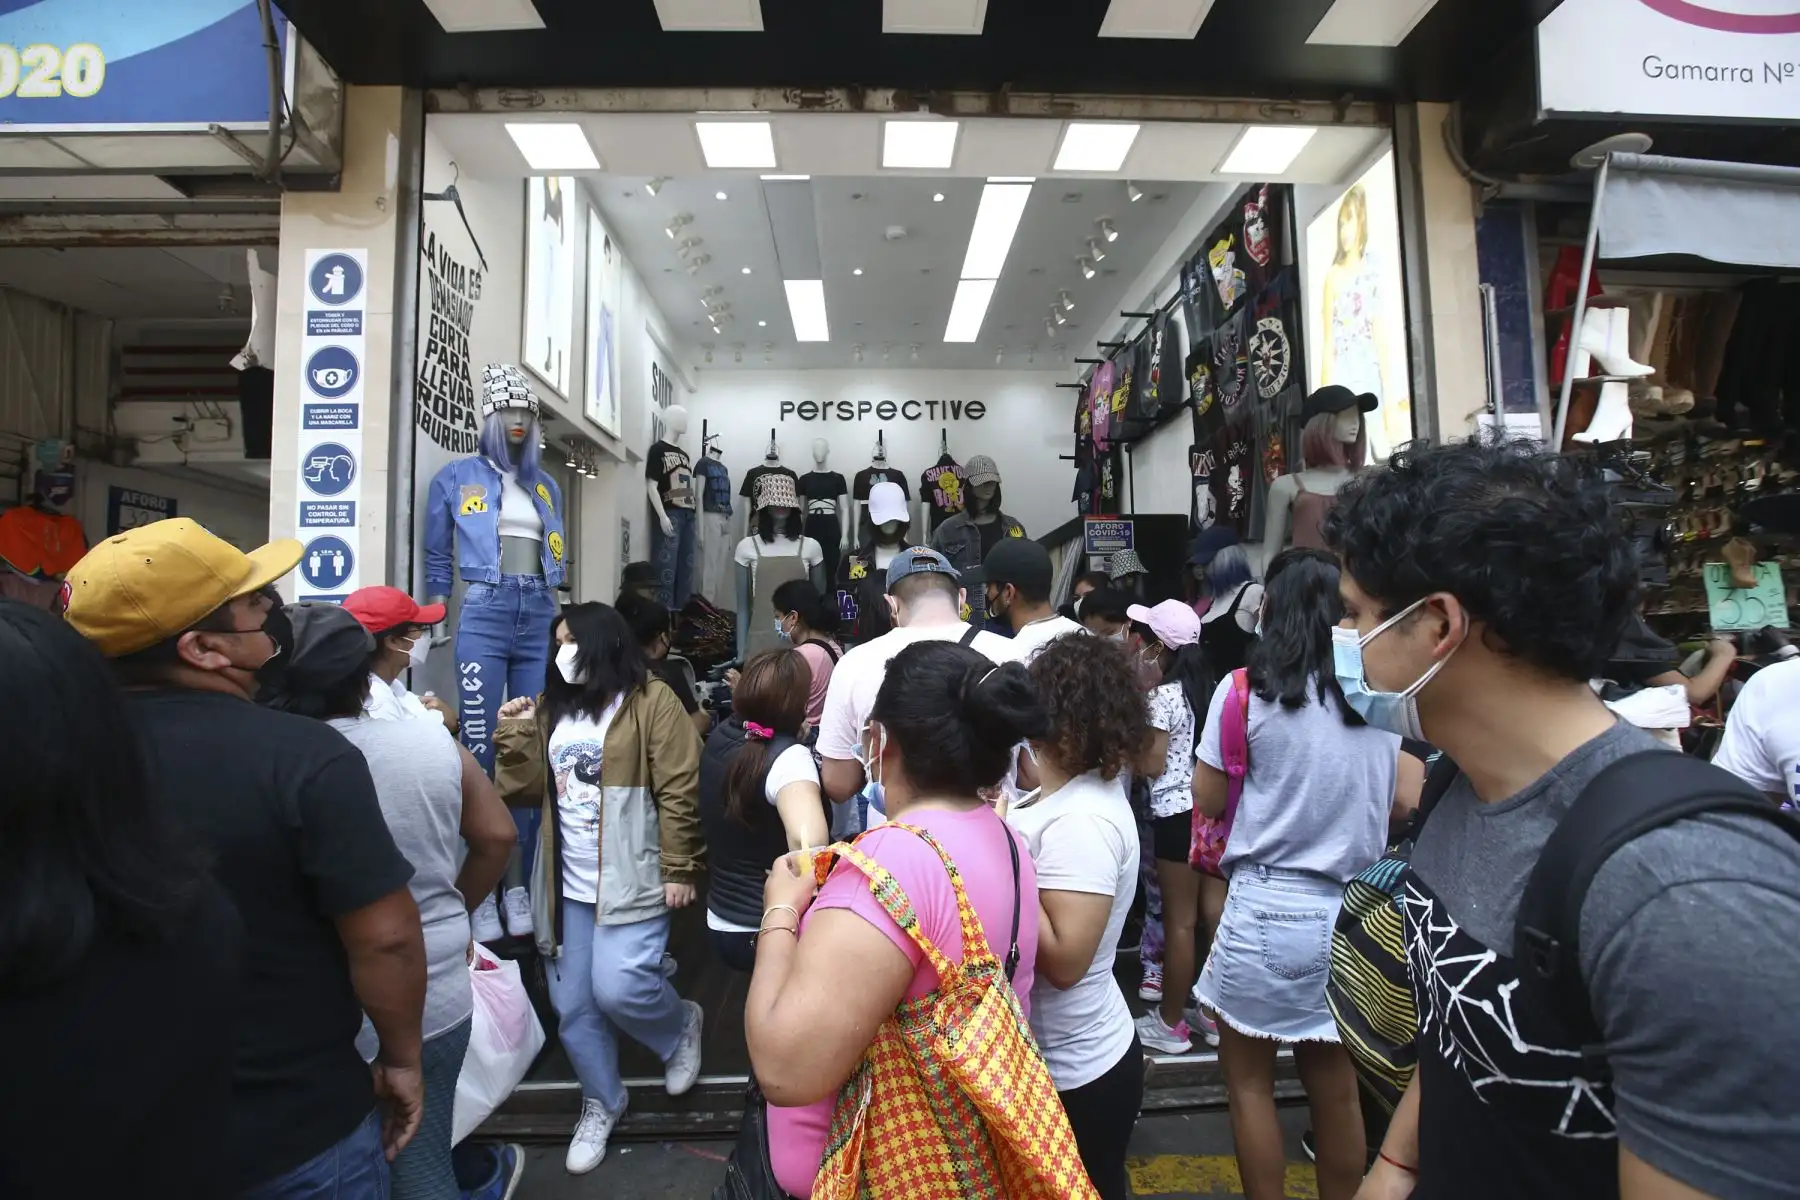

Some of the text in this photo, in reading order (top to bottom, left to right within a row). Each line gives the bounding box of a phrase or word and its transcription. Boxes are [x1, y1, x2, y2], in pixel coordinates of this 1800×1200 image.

[1642, 55, 1753, 83] Gamarra
[421, 222, 482, 300] LA VIDA ES
[428, 267, 474, 337] DEMASIADO
[425, 337, 472, 388] PARA
[430, 312, 470, 364] CORTA
[417, 380, 478, 431] ROPA
[419, 359, 476, 411] LLEVAR
[120, 491, 168, 510] AFORO
